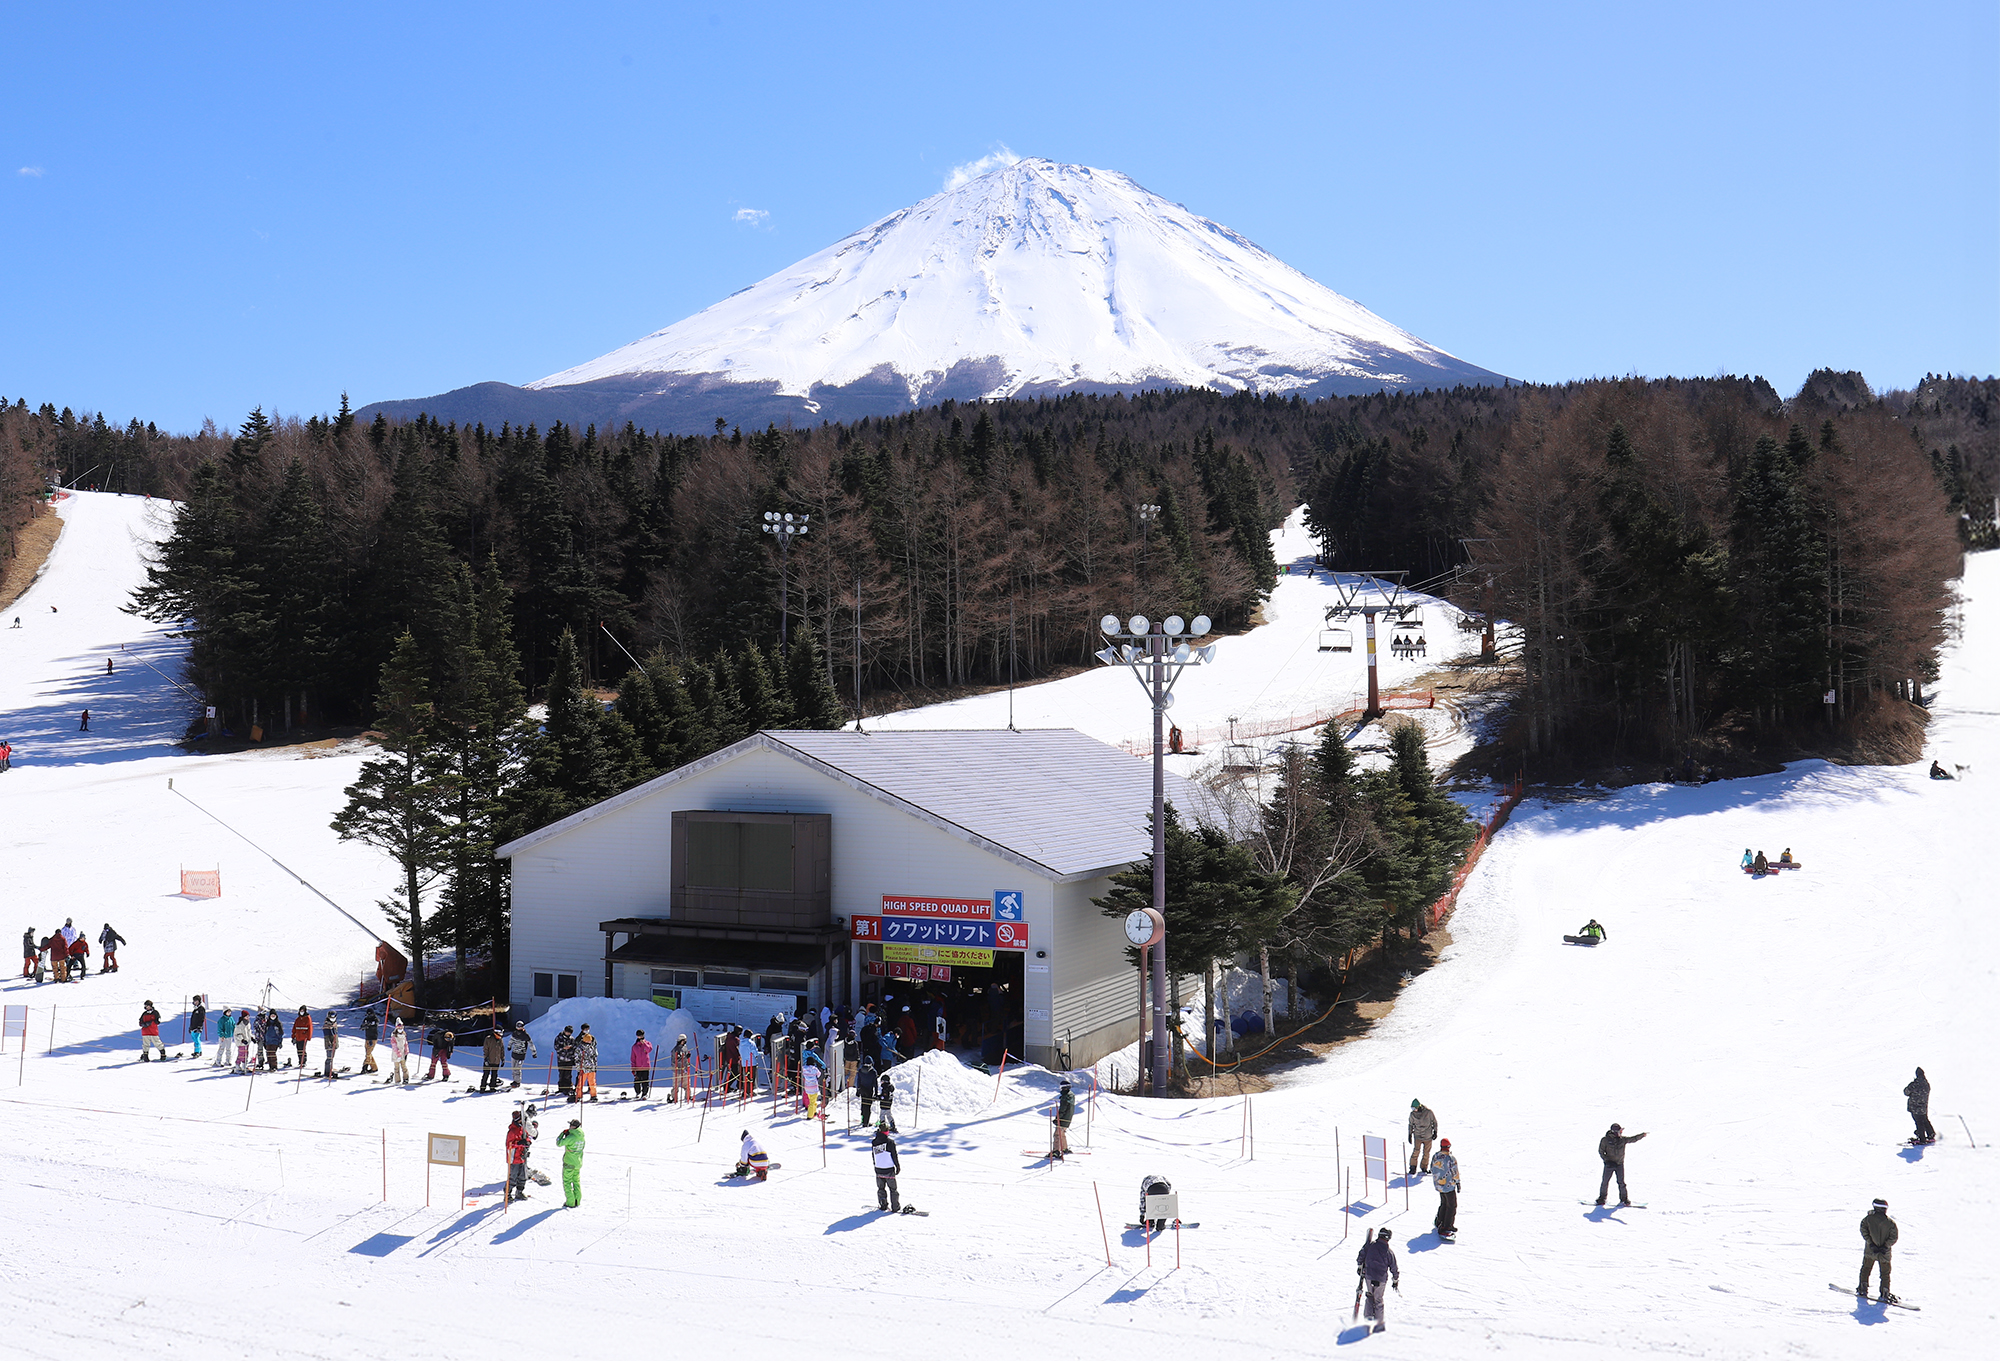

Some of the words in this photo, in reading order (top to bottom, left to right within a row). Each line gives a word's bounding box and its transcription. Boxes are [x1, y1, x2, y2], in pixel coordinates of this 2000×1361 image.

[883, 901, 907, 910] HIGH
[909, 902, 938, 911] SPEED
[941, 903, 969, 914] QUAD
[971, 905, 991, 915] LIFT
[856, 920, 877, 936] 第1
[888, 922, 989, 942] クワッドリフト
[938, 950, 990, 959] にご協力ください
[875, 964, 879, 974] 1
[895, 965, 901, 975] 2
[915, 966, 922, 977] 3
[937, 968, 944, 979] 4
